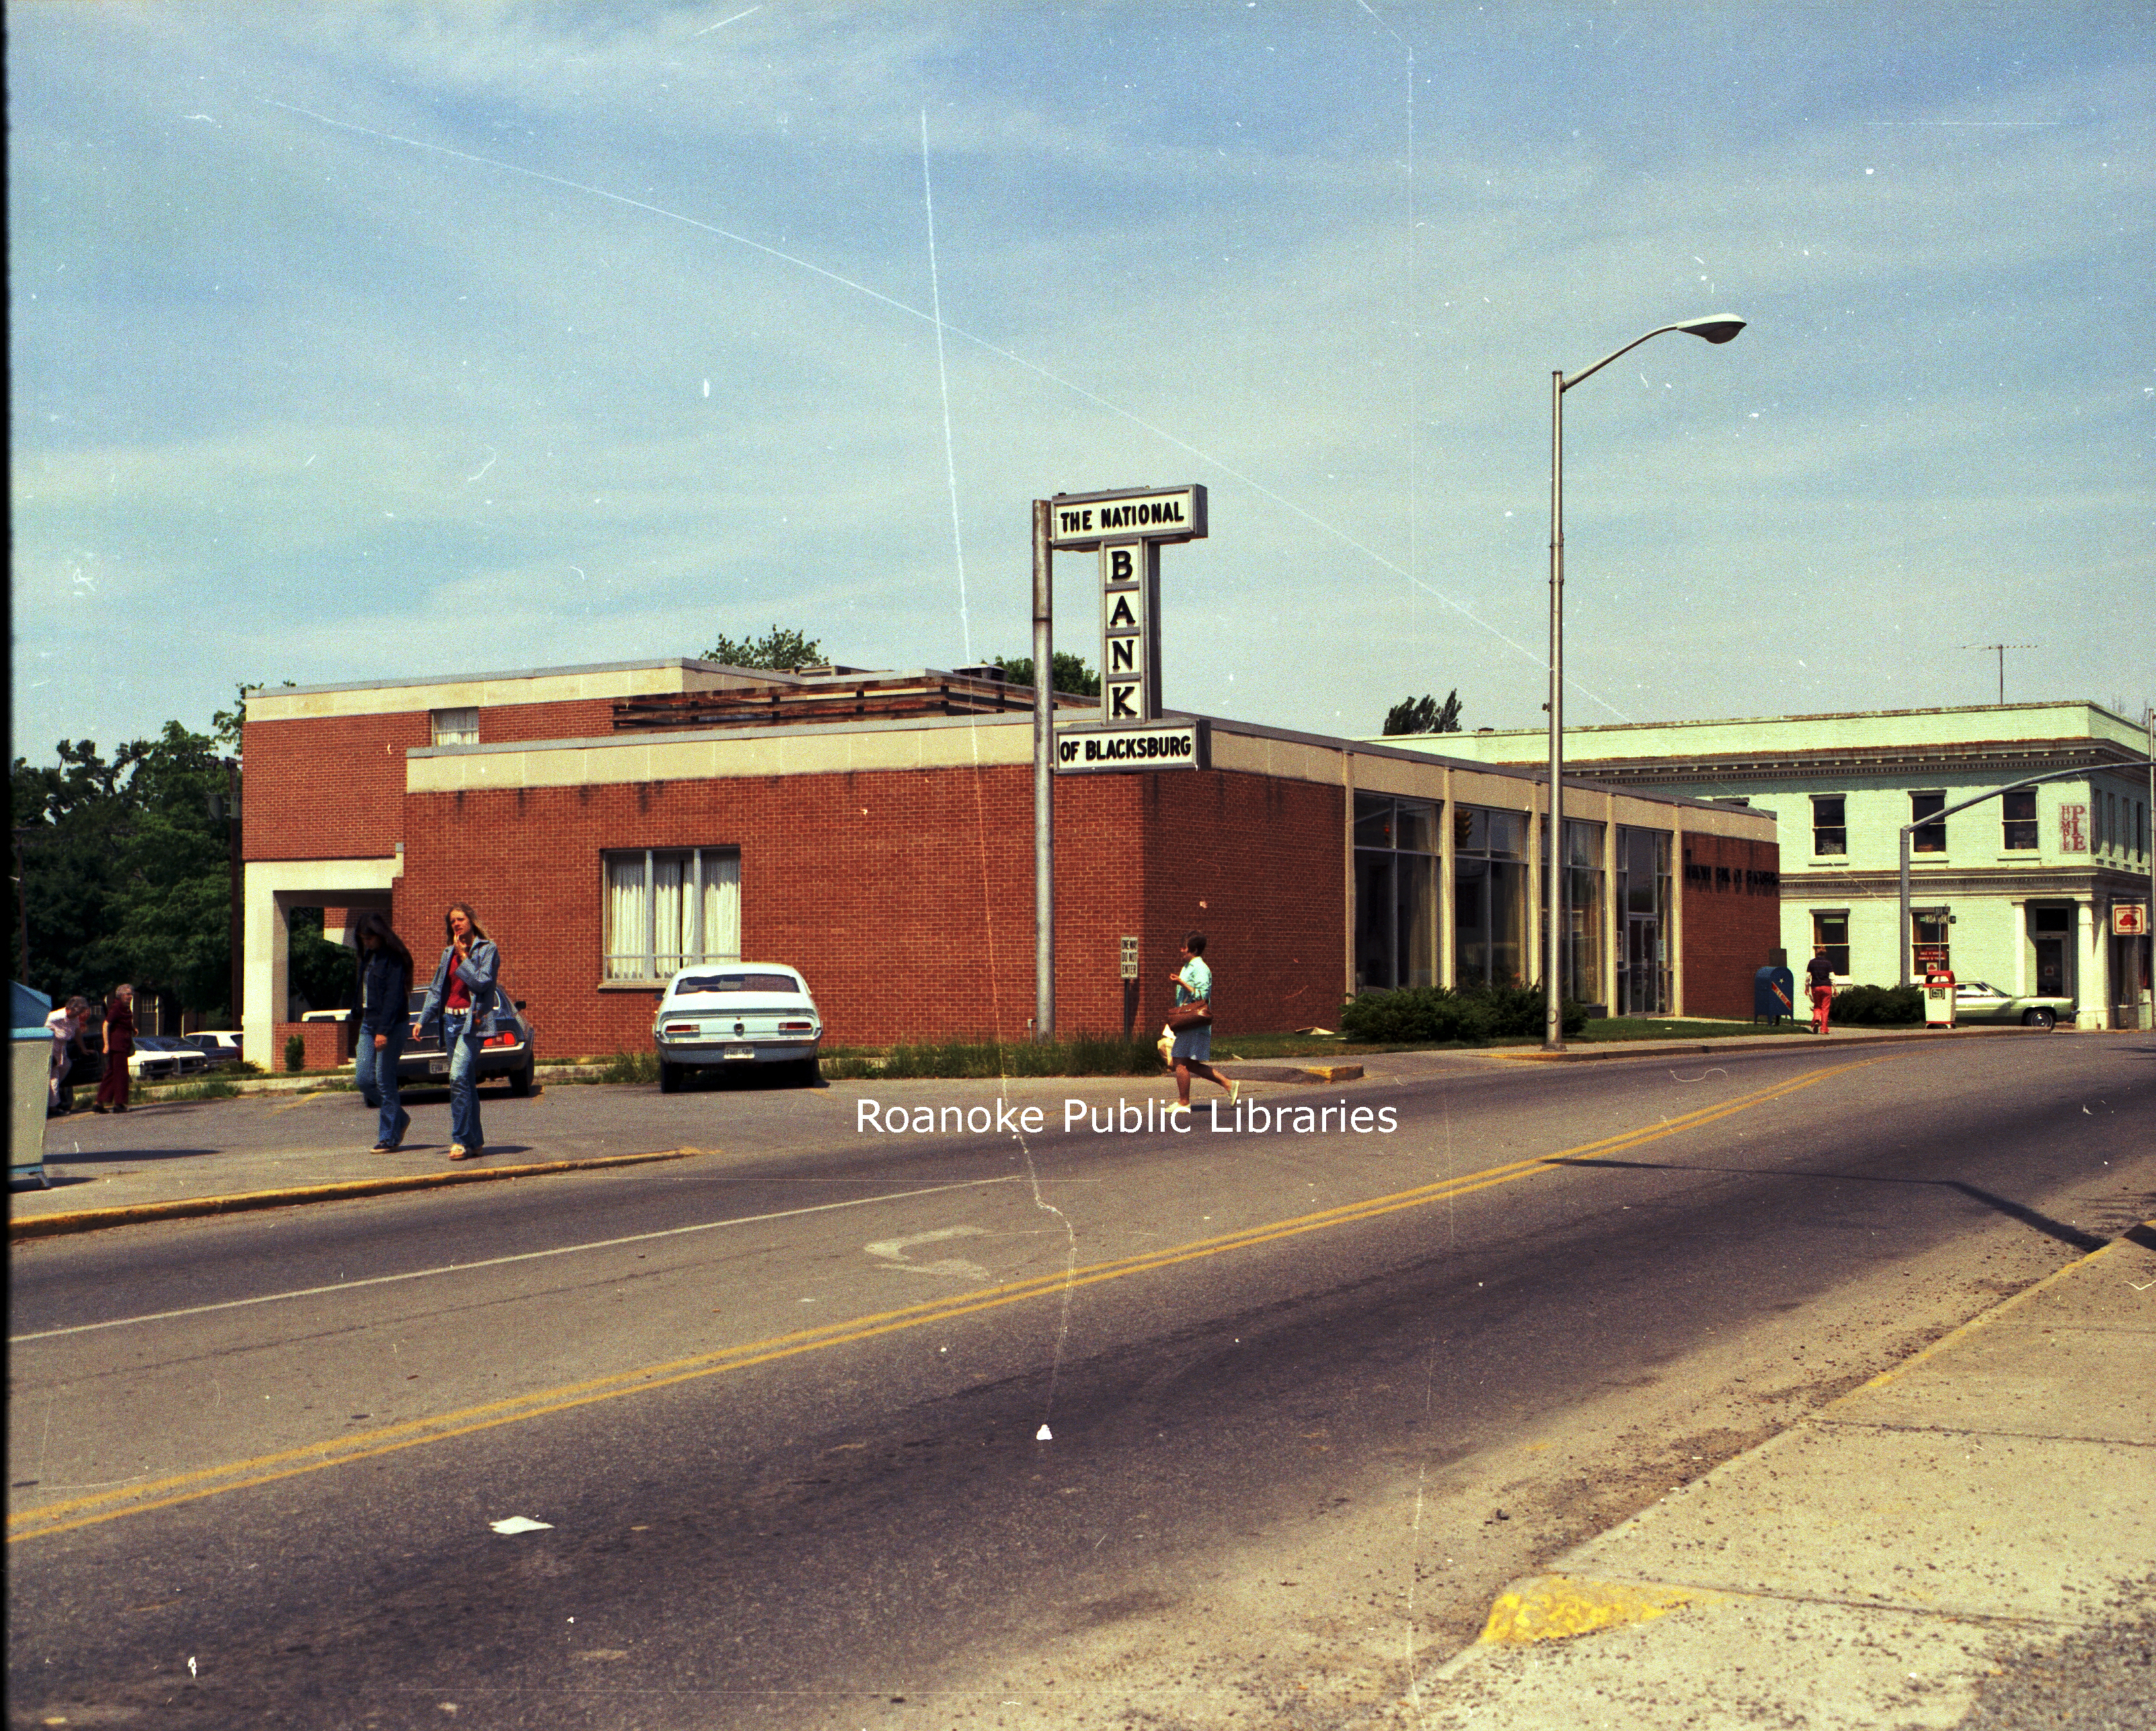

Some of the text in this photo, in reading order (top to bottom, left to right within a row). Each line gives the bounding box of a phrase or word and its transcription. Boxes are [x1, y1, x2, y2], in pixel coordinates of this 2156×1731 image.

[1060, 501, 1184, 533] THE NATIONAL
[1110, 550, 1137, 718] BANK
[1060, 734, 1192, 762] OF BLACKSBURG
[2061, 805, 2071, 851] HUMBLE
[2071, 805, 2086, 851] PIE
[1122, 964, 1137, 975] ENTER
